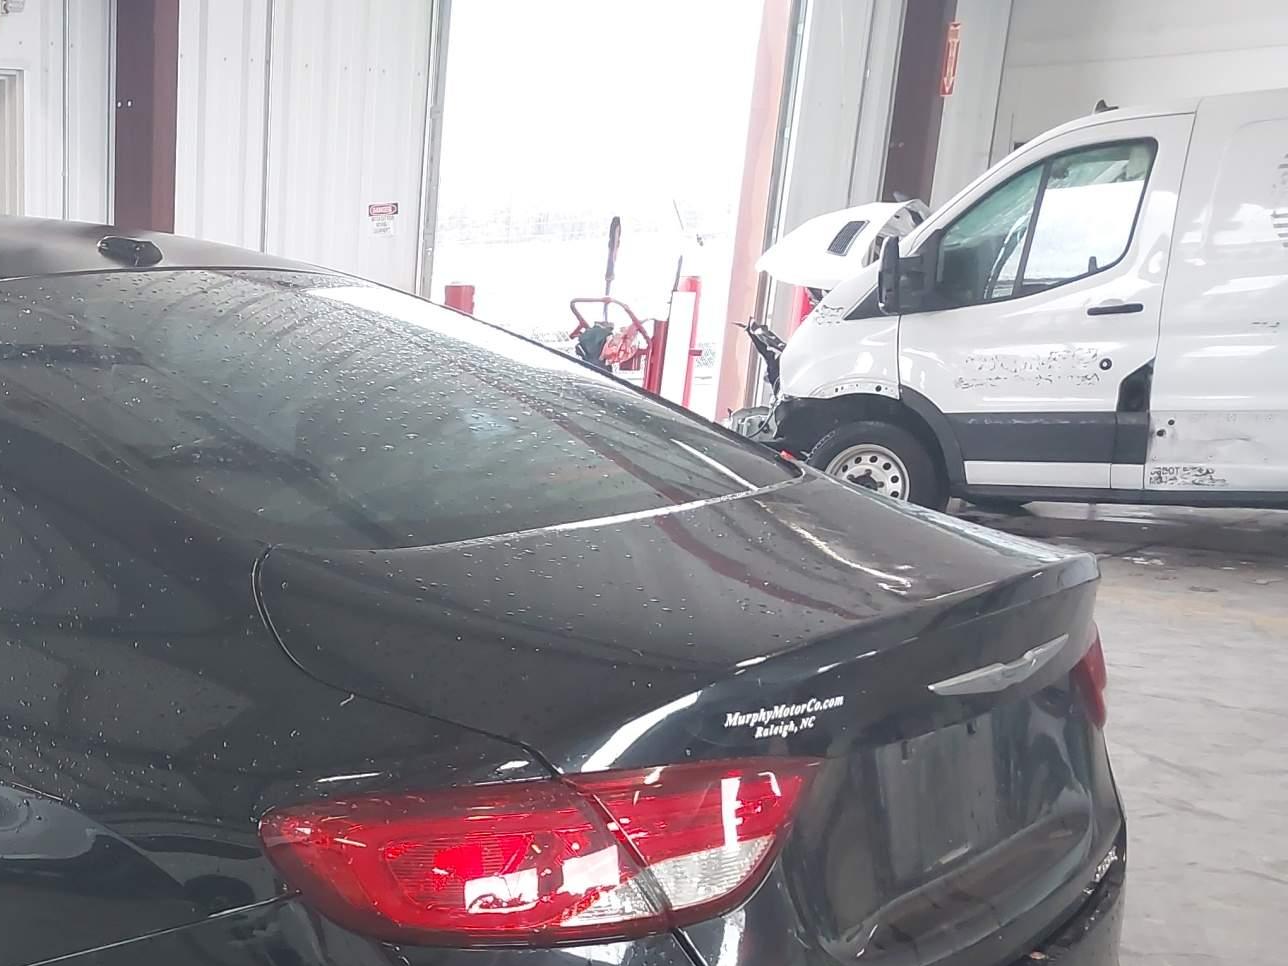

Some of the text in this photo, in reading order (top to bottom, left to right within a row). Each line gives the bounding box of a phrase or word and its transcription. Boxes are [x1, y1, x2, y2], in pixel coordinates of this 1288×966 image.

[724, 695, 844, 728] MurphyMotorCo.com
[754, 716, 816, 739] Raleigh, NC
